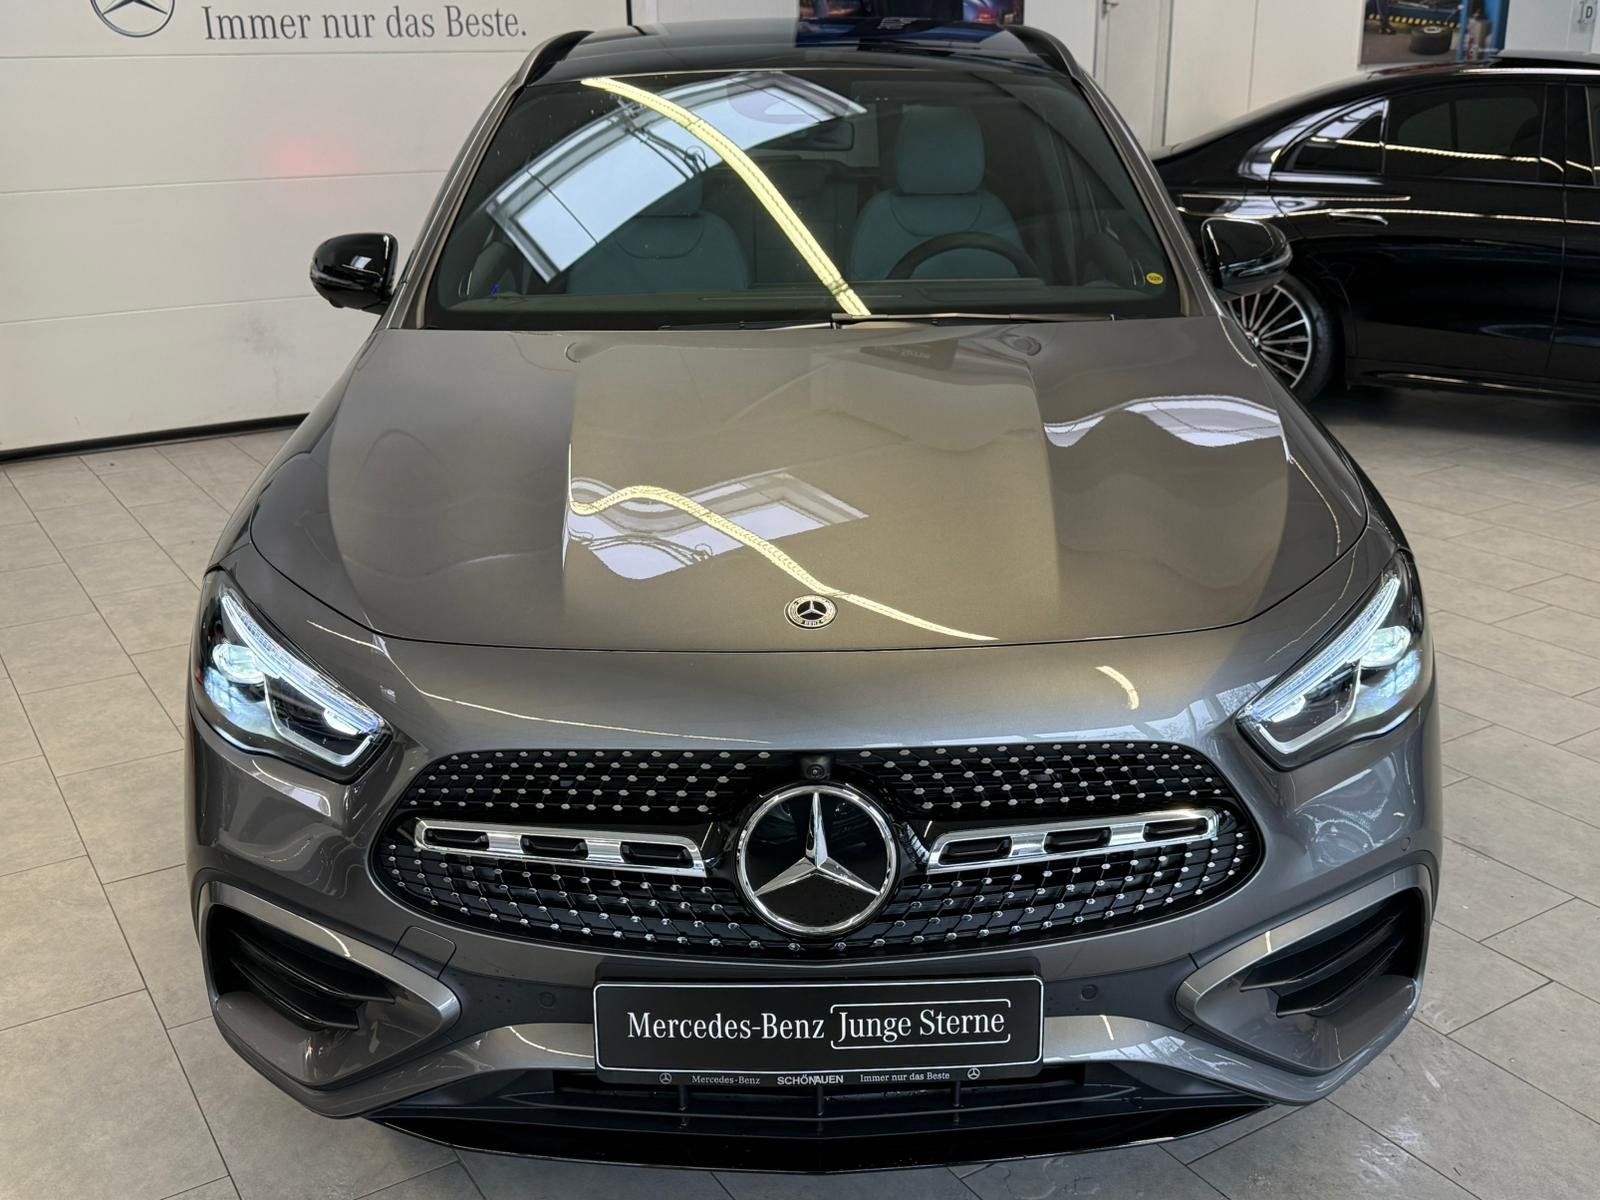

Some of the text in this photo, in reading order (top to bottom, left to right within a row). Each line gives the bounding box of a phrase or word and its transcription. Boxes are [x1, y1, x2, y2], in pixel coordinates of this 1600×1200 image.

[201, 4, 527, 40] Immer nur das Beste.
[626, 1008, 1005, 1043] Mercedes-Benz Junge Sterne
[691, 1074, 760, 1085] Mercedes-Benz
[860, 1073, 890, 1083] Immer
[909, 1073, 925, 1081] das
[927, 1072, 950, 1081] Beste
